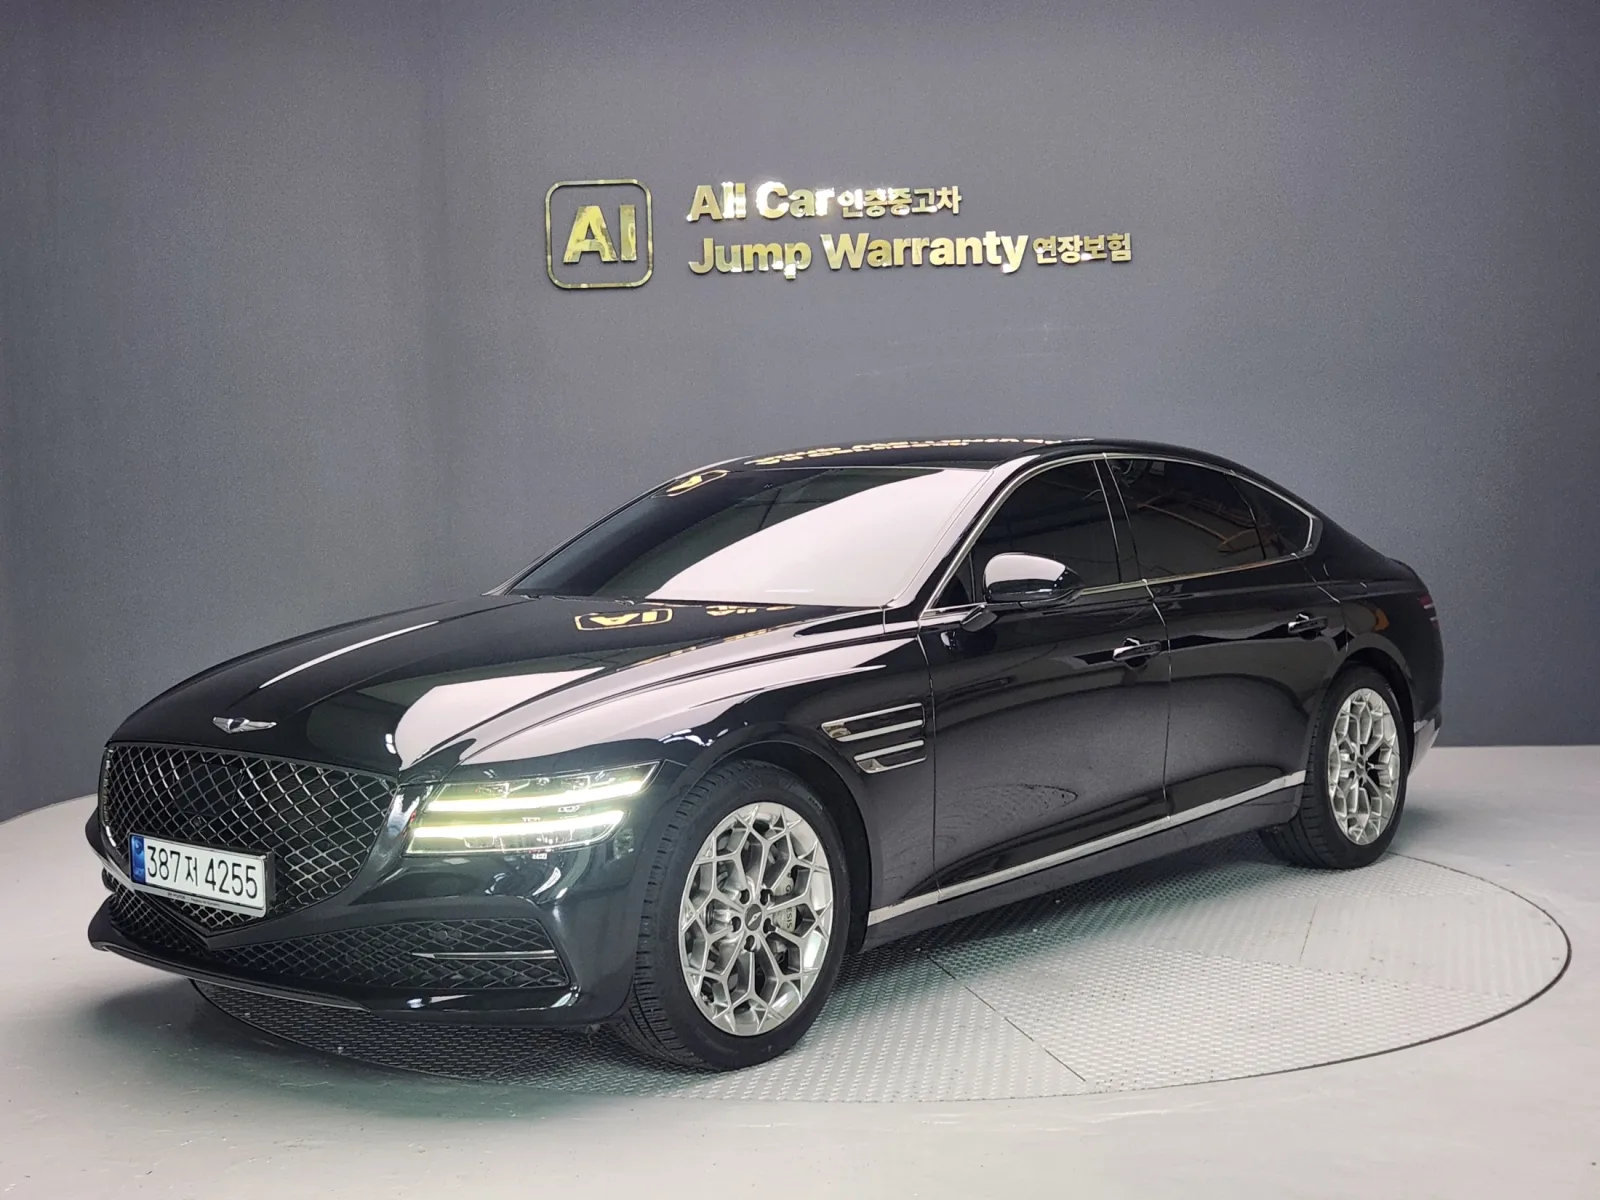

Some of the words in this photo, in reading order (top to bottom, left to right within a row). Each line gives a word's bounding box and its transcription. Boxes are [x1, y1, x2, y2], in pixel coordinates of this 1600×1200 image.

[686, 181, 747, 222] All
[755, 180, 836, 219] Car
[837, 186, 962, 219] 인증중고차
[563, 204, 637, 263] AI
[688, 237, 813, 280] Jump
[820, 230, 1029, 274] Warranty
[1032, 232, 1132, 264] 연장보험
[147, 845, 199, 887] 387저
[204, 857, 258, 899] 4255
